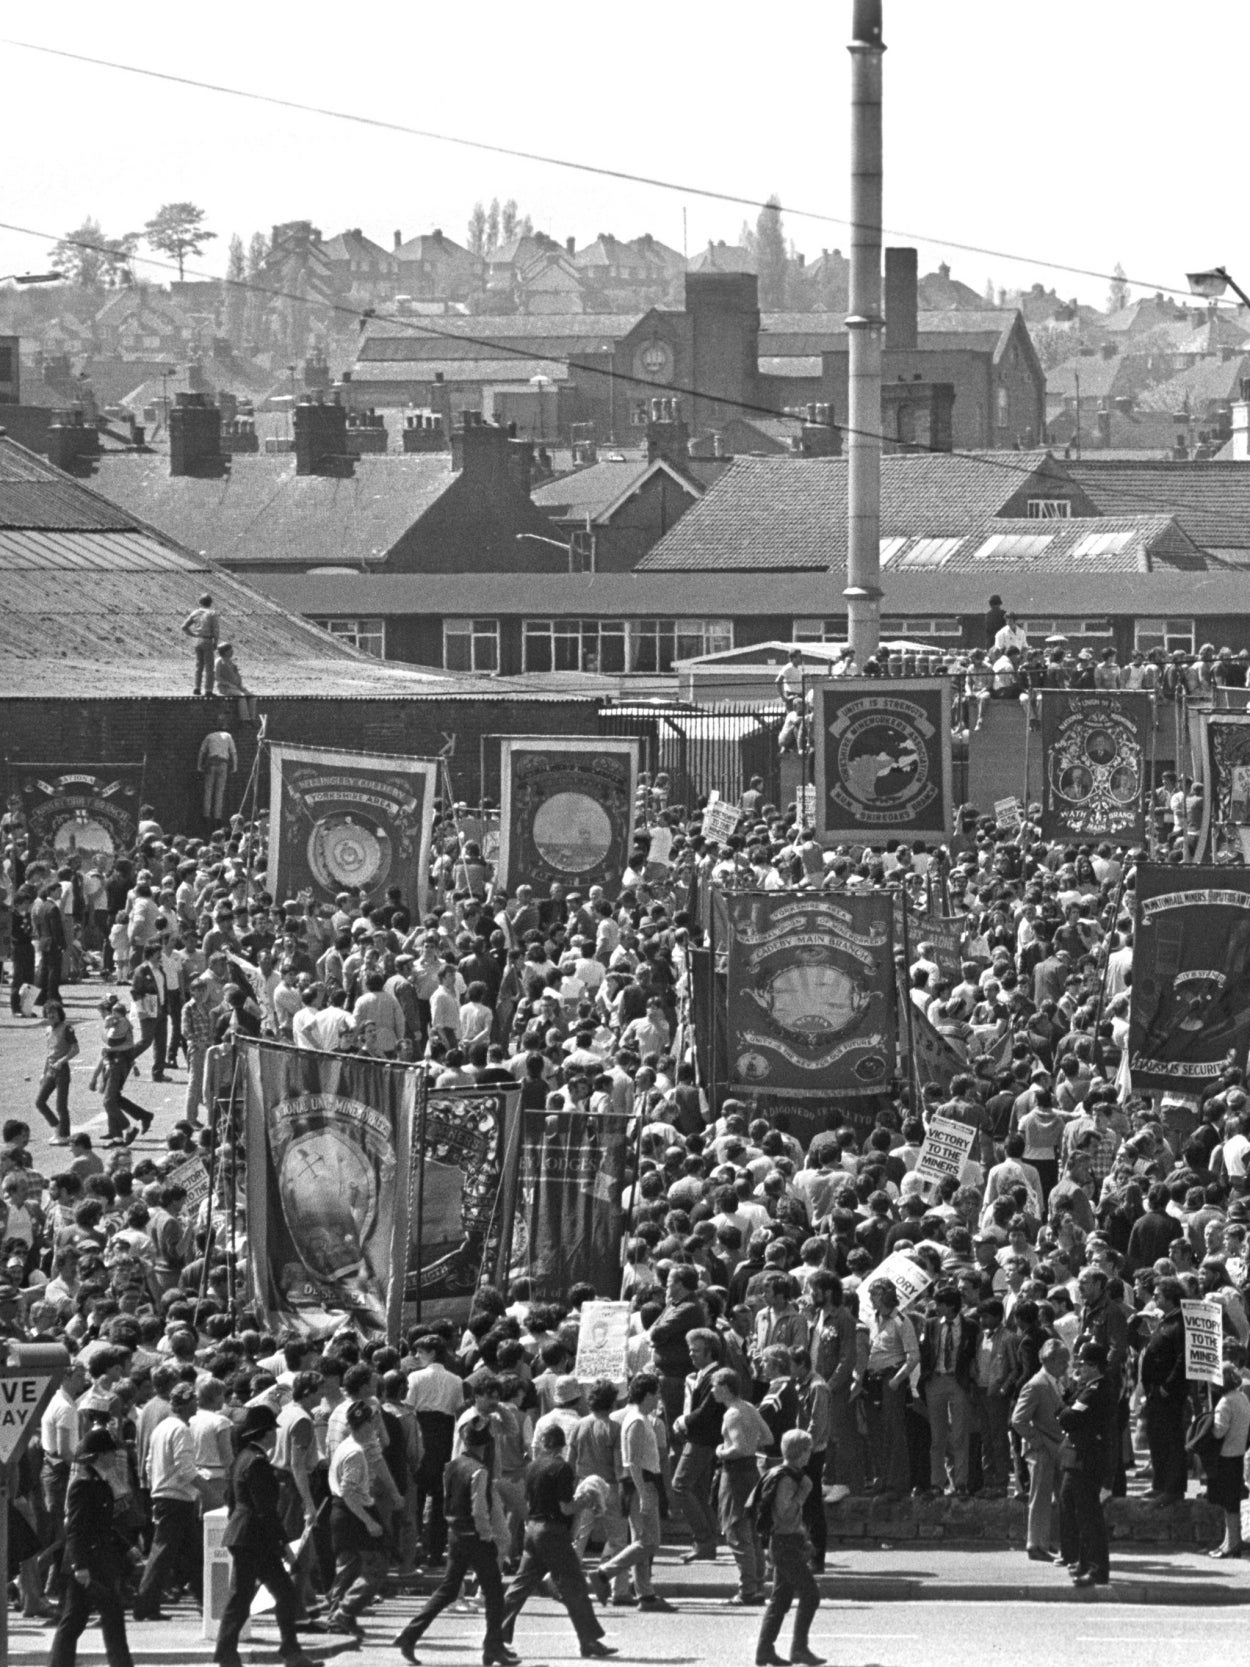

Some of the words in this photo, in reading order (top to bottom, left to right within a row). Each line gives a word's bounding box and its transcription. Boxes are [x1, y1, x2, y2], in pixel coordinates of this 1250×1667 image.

[841, 700, 865, 716] UNITY
[869, 699, 877, 707] IS
[883, 699, 926, 719] STRENGTH
[358, 778, 407, 800] COLLIERY
[313, 791, 362, 801] YORKSHIRE
[365, 794, 392, 811] AREA
[1060, 810, 1087, 818] WATH
[772, 902, 819, 919] YORKSHIRE
[825, 904, 848, 919] AREA
[756, 938, 793, 958] CADEBY
[797, 934, 825, 944] MAIN
[828, 935, 869, 962] BRANCH
[1169, 1063, 1180, 1074] IS
[1182, 1063, 1220, 1076] SECURIT
[928, 1127, 970, 1149] VICTORY
[928, 1142, 942, 1154] TO
[942, 1147, 962, 1160] THE
[921, 1155, 960, 1175] MINERS
[181, 1169, 207, 1188] CTORY
[1185, 1315, 1221, 1331] VICTORY
[1191, 1333, 1204, 1345] TO
[1190, 1349, 1220, 1365] MINERS
[1, 1381, 37, 1404] VE
[2, 1409, 28, 1426] AY
